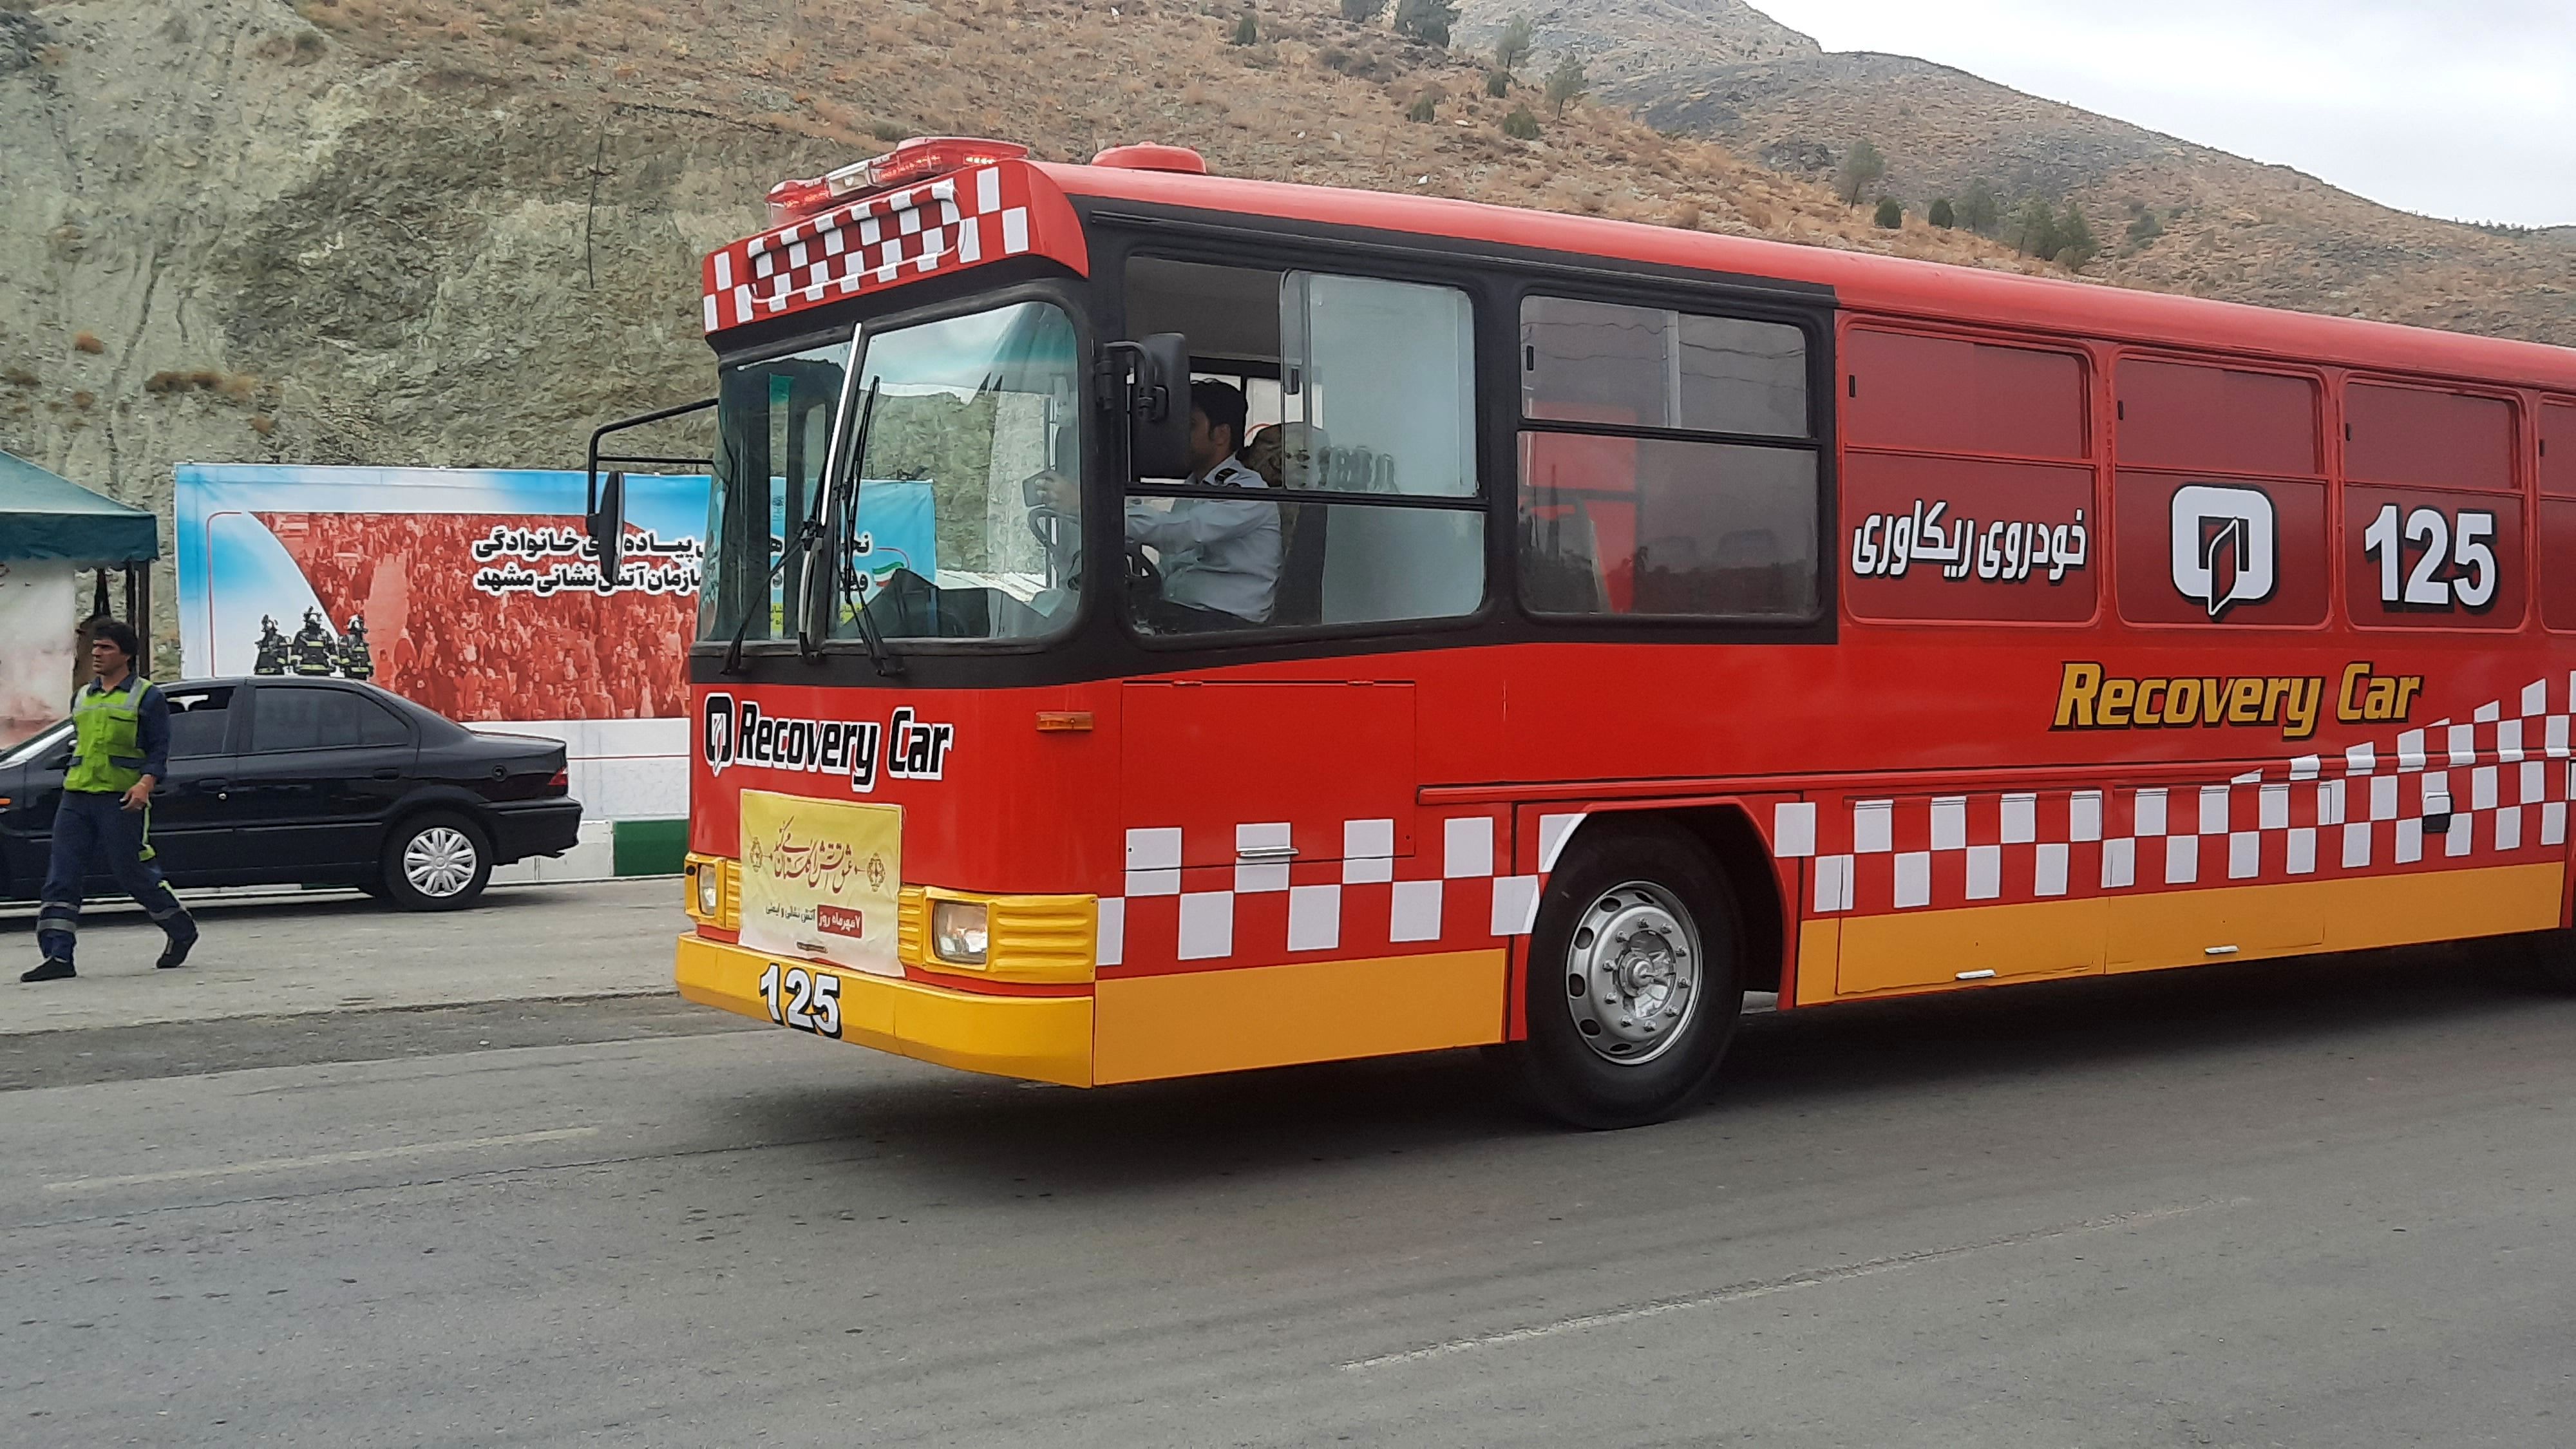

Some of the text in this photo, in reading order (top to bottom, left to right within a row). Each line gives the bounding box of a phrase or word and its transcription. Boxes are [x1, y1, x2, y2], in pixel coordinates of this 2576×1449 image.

[476, 529, 580, 558] خانوادگی
[1852, 498, 2087, 581] خودروی ریکاوری
[2363, 504, 2497, 609] 125
[477, 565, 534, 591] مشهد
[537, 565, 596, 592] نشانی
[647, 567, 701, 592] ازمان
[2052, 662, 2423, 739] Recovery Car
[737, 702, 952, 790] Recovery Car
[760, 963, 842, 1037] 125
